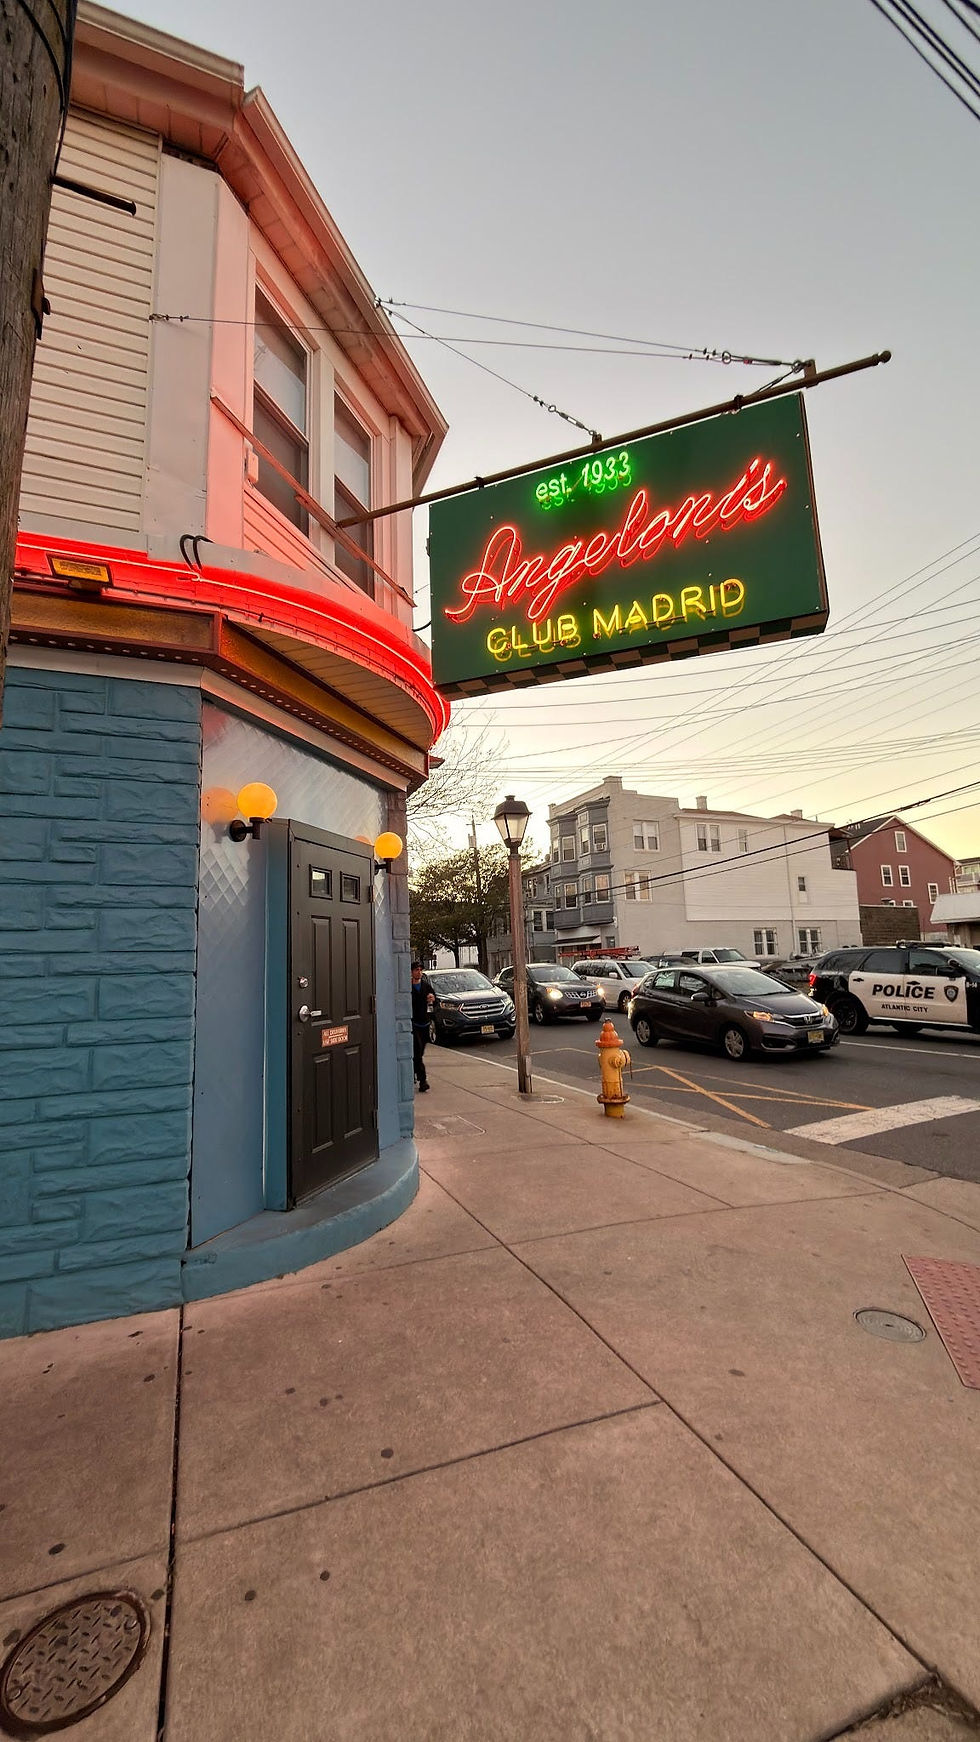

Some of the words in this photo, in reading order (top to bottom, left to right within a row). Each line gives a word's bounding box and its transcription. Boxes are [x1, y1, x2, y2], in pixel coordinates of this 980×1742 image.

[535, 473, 572, 500] est.
[581, 451, 630, 488] 1933
[444, 458, 786, 620] Angeloni's
[486, 614, 578, 655] CLUB
[592, 577, 746, 636] MADRID
[872, 984, 935, 999] POLICE
[881, 1003, 911, 1012] ATLANTIC
